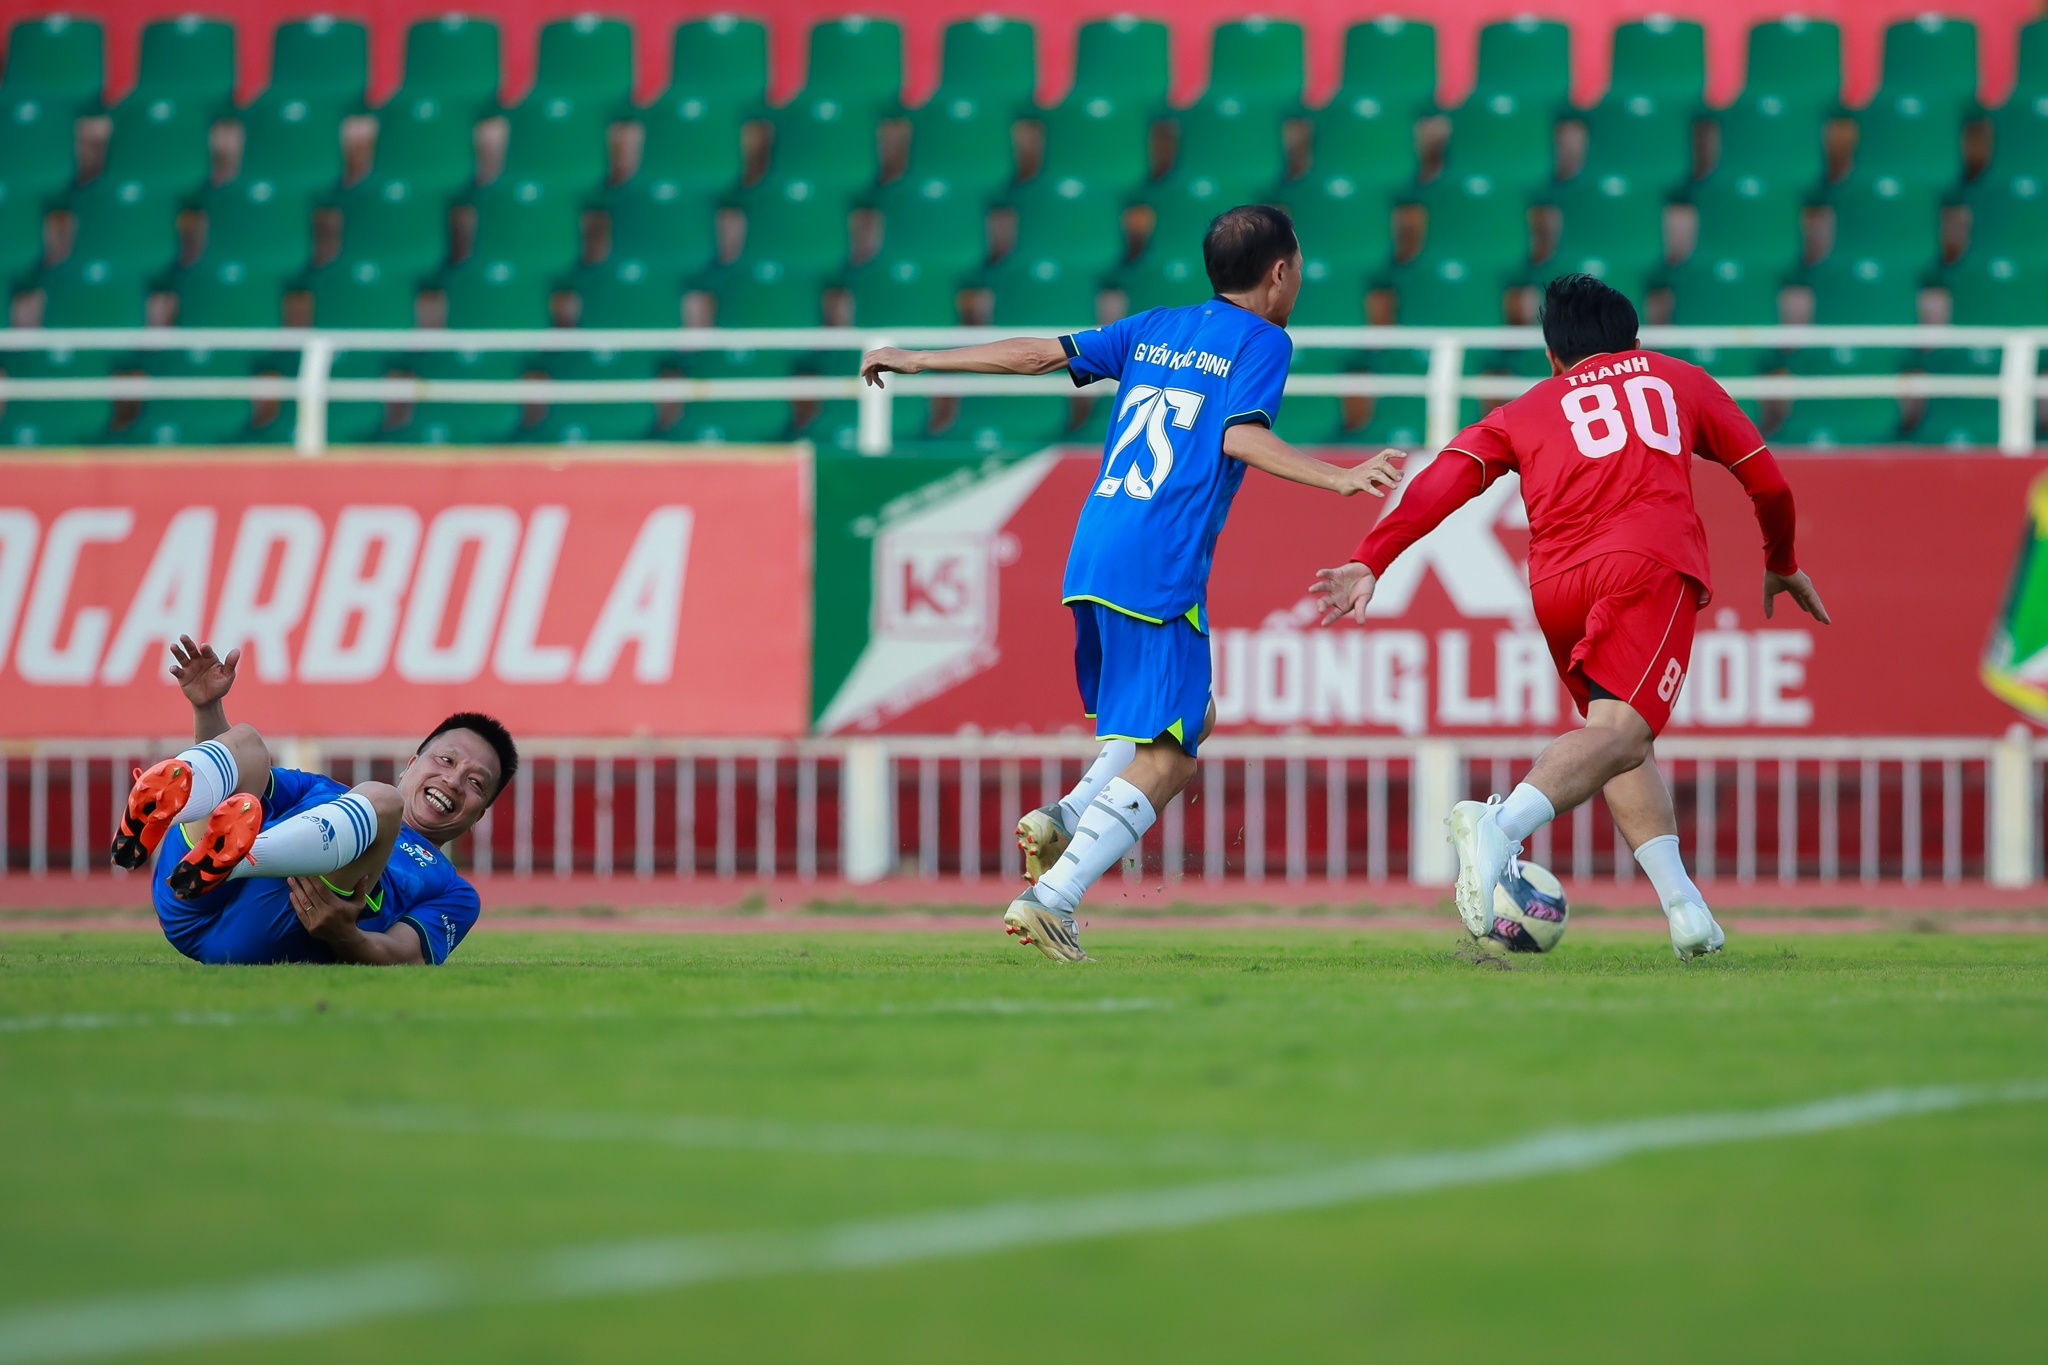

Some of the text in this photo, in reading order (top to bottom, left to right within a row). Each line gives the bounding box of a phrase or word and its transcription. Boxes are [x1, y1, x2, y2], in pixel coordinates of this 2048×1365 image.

[1196, 352, 1231, 377] ĐỊNH
[1564, 357, 1650, 386] THÀNH
[1095, 385, 1205, 499] 25
[1561, 375, 1682, 458] 80
